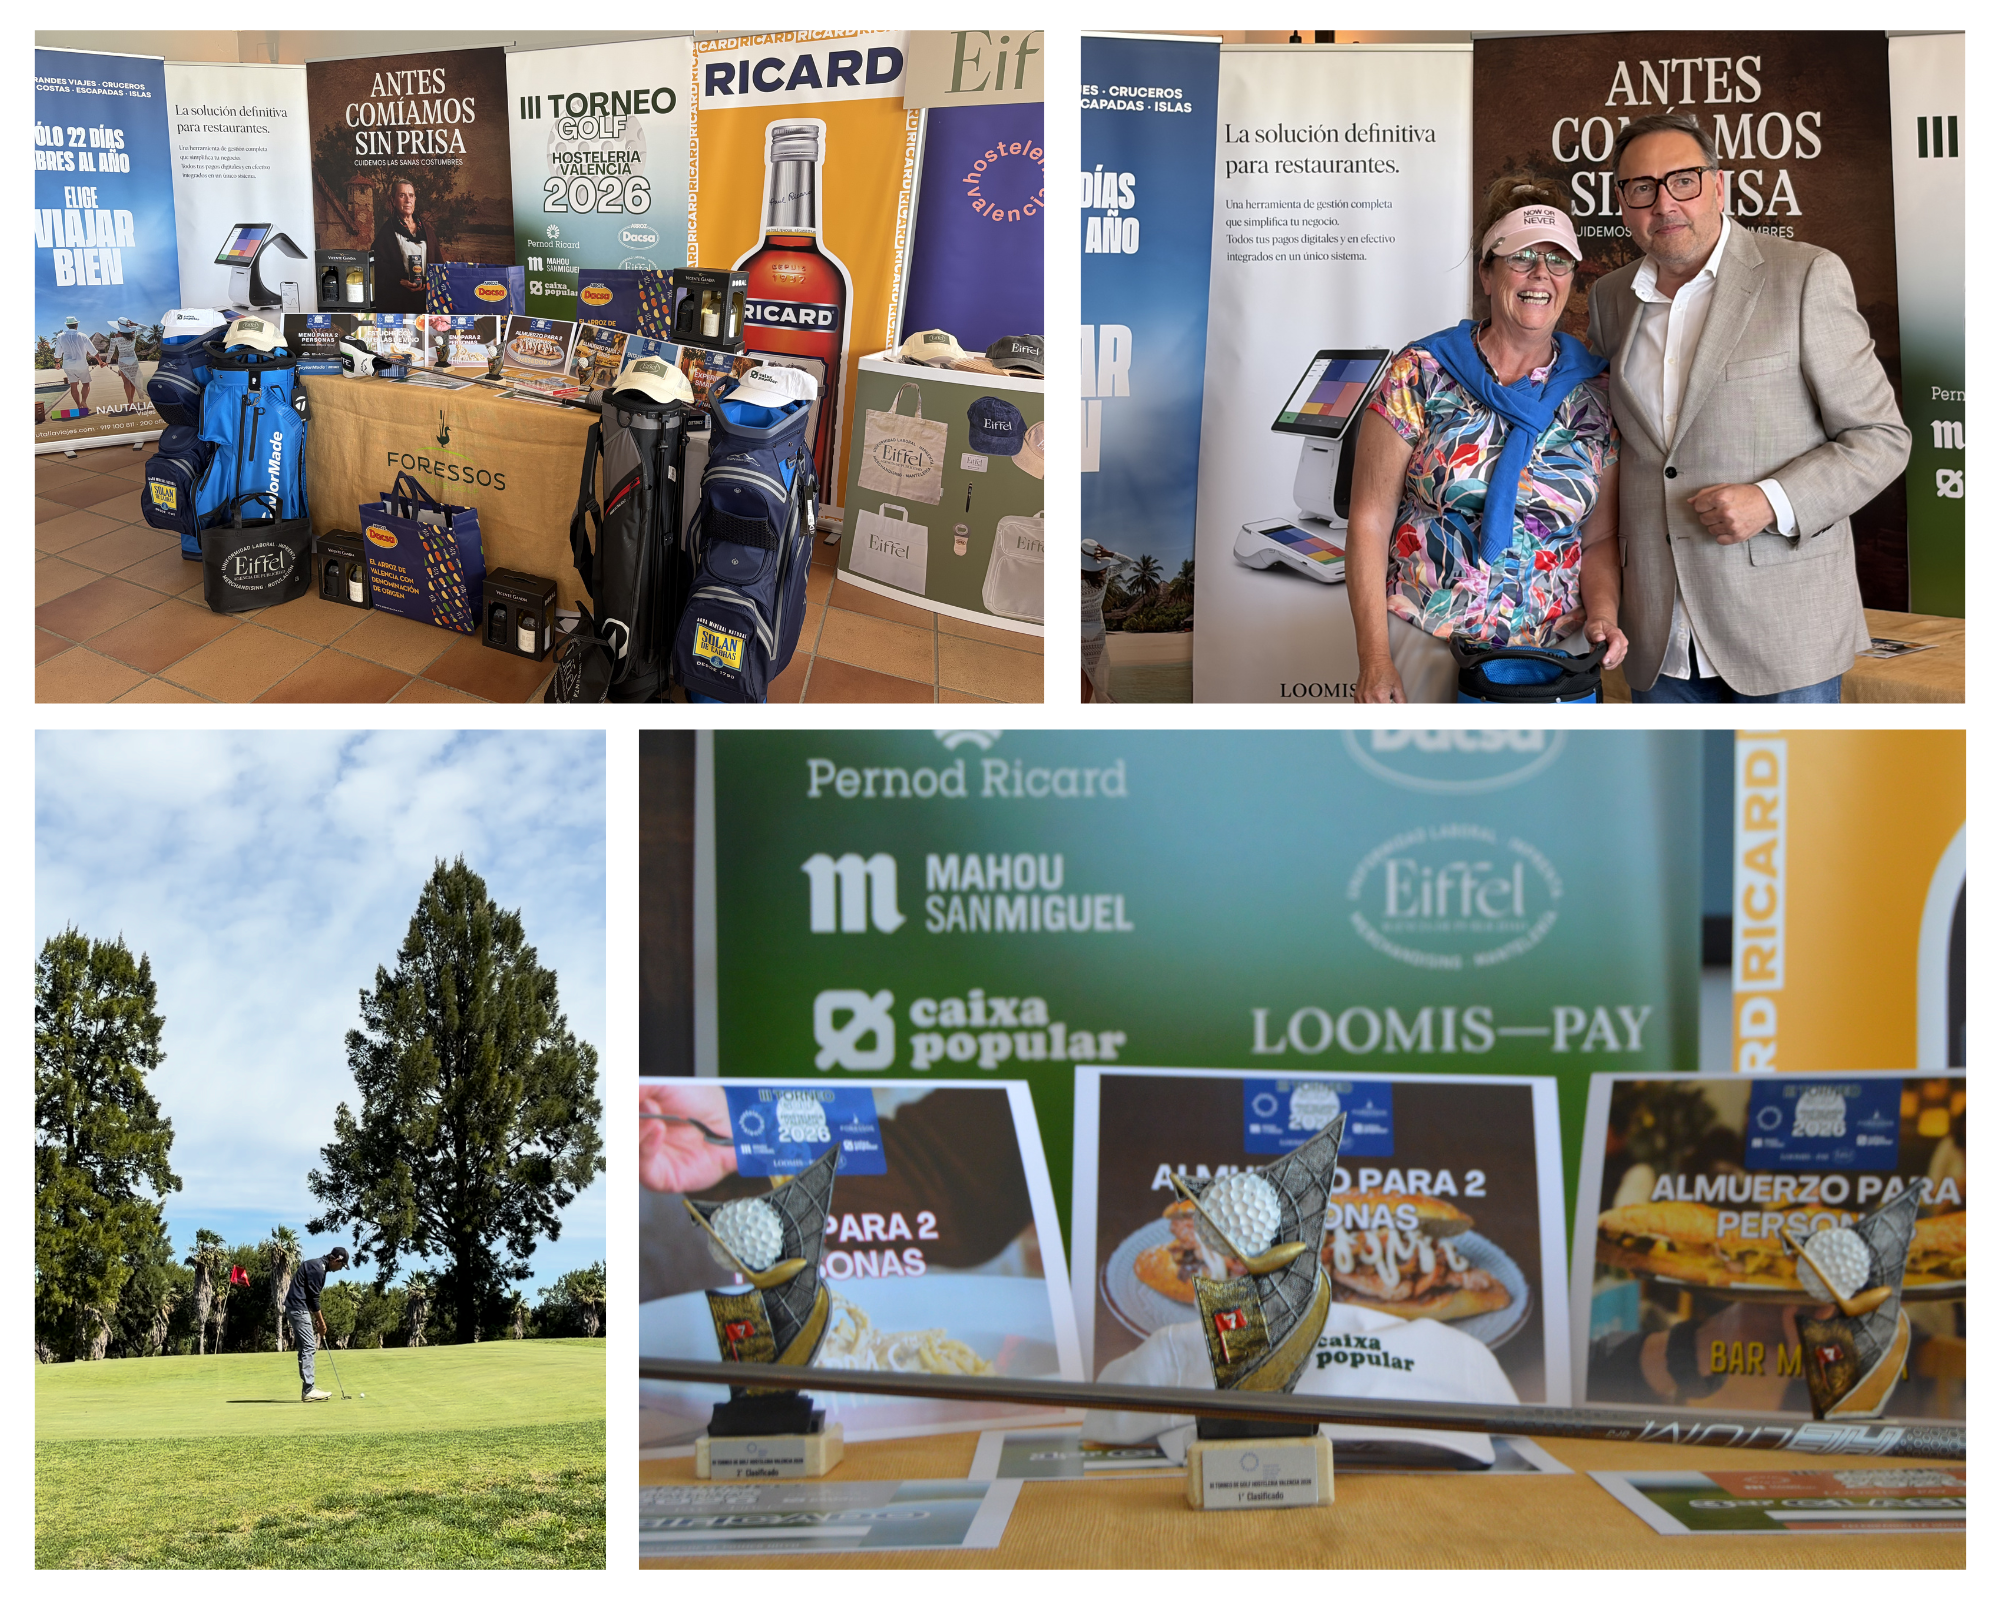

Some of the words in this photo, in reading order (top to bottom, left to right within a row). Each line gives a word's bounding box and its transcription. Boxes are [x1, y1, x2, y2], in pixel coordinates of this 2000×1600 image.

[740, 33, 795, 47] RICARD
[705, 46, 904, 97] RICARD
[1605, 55, 1762, 106] ANTES
[68, 79, 96, 87] VIAJES
[102, 82, 145, 91] CRUCEROS
[370, 67, 446, 97] ANTES
[76, 87, 123, 96] ESCAPADAS
[1109, 86, 1183, 99] CRUCEROS
[175, 104, 189, 117] La
[191, 105, 237, 118] solución
[239, 106, 288, 118] definitiva
[345, 96, 476, 128] COMÍAMOS
[519, 95, 541, 120] III
[548, 87, 676, 118] TORNEO
[1154, 101, 1192, 113] ISLAS
[66, 126, 87, 148] 22
[89, 124, 125, 149] DÍAS
[177, 123, 200, 135] para
[203, 123, 270, 134] restaurantes.
[557, 115, 627, 140] GOLF
[1225, 123, 1250, 144] La
[1255, 122, 1339, 145] solución
[1345, 122, 1436, 144] definitiva
[1917, 115, 1958, 158] III
[355, 130, 392, 156] SIN
[396, 128, 466, 155] PRISA
[79, 151, 97, 172] AL
[99, 148, 130, 173] AÑO
[354, 159, 386, 167] CUIDEMOS
[387, 159, 398, 167] LAS
[420, 158, 463, 166] COSTUMBRES
[560, 163, 631, 176] VALENCIA
[1225, 157, 1269, 179] para
[1275, 156, 1400, 175] restaurantes.
[64, 186, 98, 209] ELIGE
[543, 176, 651, 215] 2026
[1225, 200, 1243, 210] Una
[1245, 199, 1301, 210] herramienta
[1303, 200, 1315, 210] de
[1316, 199, 1349, 213] gestión
[1351, 199, 1393, 213] completa
[1523, 209, 1541, 217] NOW
[35, 208, 135, 248] VIAJAR
[1225, 218, 1242, 229] que
[1244, 216, 1288, 229] simplifica
[1290, 217, 1300, 227] tu
[1302, 217, 1339, 229] negocio.
[1523, 216, 1556, 226] NEVER
[622, 231, 656, 243] Dacsa
[1085, 209, 1140, 255] AÑO
[1226, 233, 1254, 244] Todos
[1256, 235, 1270, 244] tus
[1272, 236, 1299, 247] pagos
[1301, 233, 1339, 247] digitales
[1347, 236, 1359, 244] en
[1360, 233, 1396, 244] efectivo
[527, 239, 553, 248] Pernod
[555, 240, 580, 249] Ricard
[1227, 251, 1273, 263] integrados
[1275, 253, 1287, 262] en
[1288, 253, 1301, 262] un
[1303, 251, 1329, 261] único
[1331, 251, 1367, 261] sistema.
[53, 248, 124, 286] BIEN
[478, 288, 504, 296] Dacsa
[584, 290, 610, 300] Dacsa
[744, 304, 833, 326] RICARD
[1012, 342, 1039, 355] Eiffel
[96, 401, 155, 414] NAUTALIA
[984, 418, 1012, 430] Eiffel
[883, 445, 922, 467] Eiffel
[387, 452, 506, 491] FORESSOS
[369, 529, 395, 543] Dacsa
[869, 534, 910, 560] Eiffel
[221, 545, 250, 571] UNIFORMIDAD
[278, 543, 296, 560] IMPRENTA
[234, 550, 284, 576] Eiffel
[377, 561, 397, 571] ARROZ
[222, 575, 263, 591] MERCHANDISING
[370, 567, 399, 581] VALENCIA
[400, 575, 414, 584] CON
[371, 577, 419, 595] DENOMINACIÓN
[381, 588, 405, 599] ORIGEN
[701, 642, 709, 650] DE
[711, 646, 736, 660] CABRAS
[806, 758, 967, 798] Pernod
[981, 758, 1128, 798] Ricard
[926, 853, 1064, 892] MAHOU
[1741, 749, 1779, 983] RICARD
[1384, 858, 1526, 919] Eiffel
[926, 894, 1134, 933] SANMIGUEL
[909, 989, 1049, 1027] caixa
[910, 1021, 1127, 1070] popular
[773, 1089, 835, 1101] TORNEO
[778, 1126, 832, 1143] 2026
[1792, 1121, 1847, 1137] 2026
[1359, 1168, 1455, 1195] PARA
[1464, 1169, 1487, 1197] 2
[1651, 1175, 1850, 1204] ALMUERZO
[917, 1211, 939, 1240] 2
[1221, 1312, 1239, 1328] 7
[736, 1325, 747, 1336] 7
[1317, 1333, 1382, 1350] caixa
[1316, 1349, 1415, 1372] popular
[1710, 1340, 1765, 1374] BAR
[746, 1468, 779, 1477] Clasificado
[1247, 1492, 1284, 1501] Clasificado
